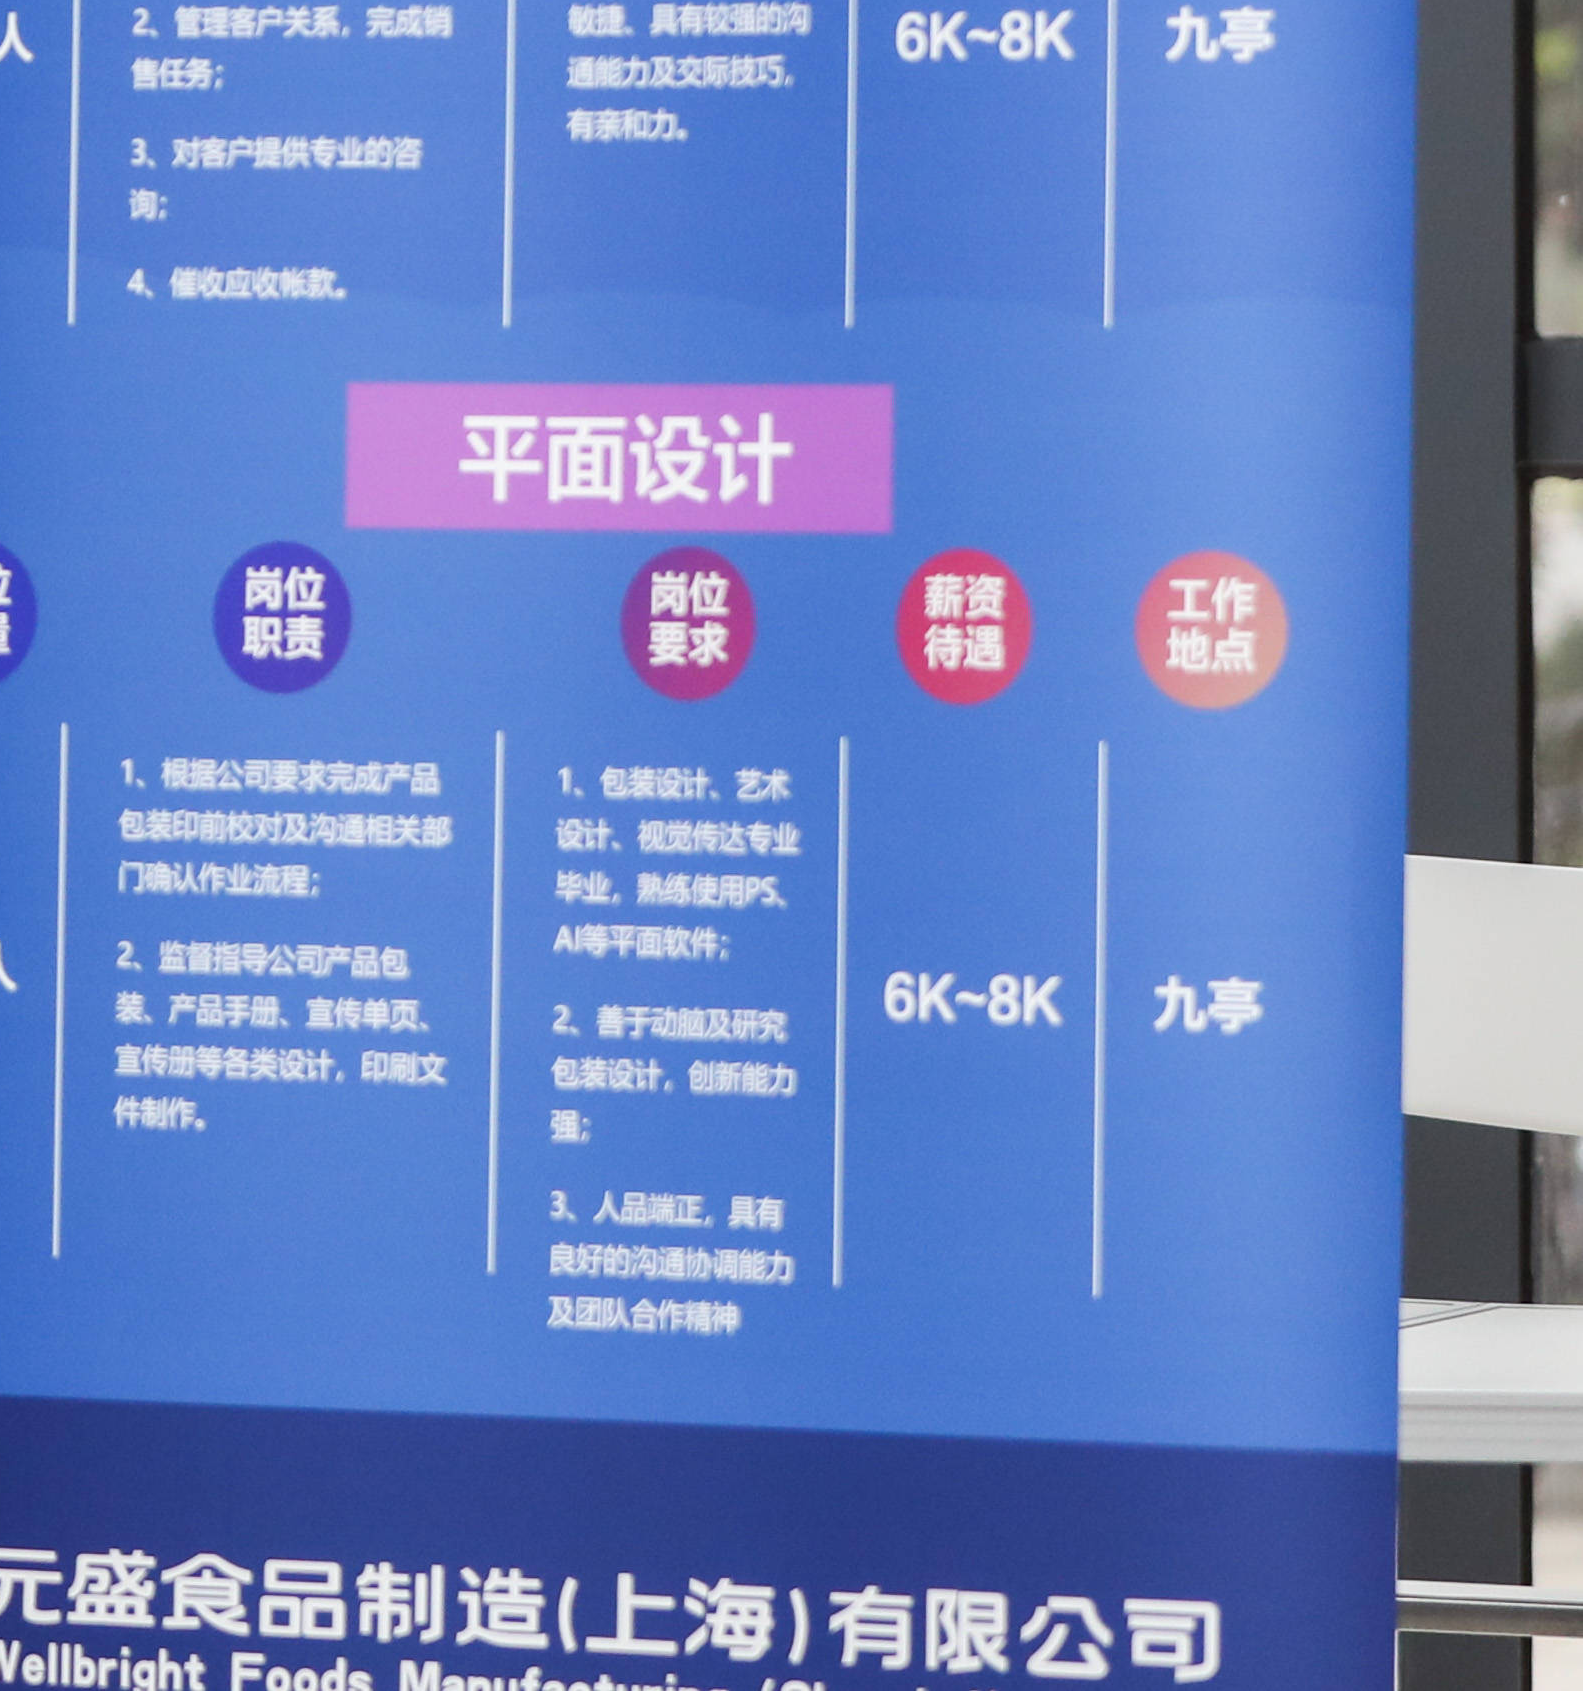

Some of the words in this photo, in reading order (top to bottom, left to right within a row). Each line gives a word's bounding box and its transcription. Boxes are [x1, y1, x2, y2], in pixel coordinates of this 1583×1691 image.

[896, 10, 1074, 62] 6K~8K
[1166, 5, 1275, 63] 九亭
[459, 413, 793, 504] 平面设计
[245, 566, 325, 610] 岗位
[651, 571, 729, 616] 岗位
[925, 574, 1005, 619] 薪资
[1168, 577, 1257, 624] 工作
[243, 615, 324, 660] 职责
[648, 621, 729, 666] 要求
[924, 624, 1005, 670] 待遇
[1167, 627, 1257, 673] 地点
[121, 757, 441, 795] 1、根据公司要求完成产品
[119, 809, 452, 847] 包装印前校对及沟通相关部
[884, 971, 1062, 1026] 6K~8K
[1154, 975, 1263, 1034] 九亭
[550, 1242, 794, 1284] 良好的沟通协调能力
[547, 1296, 741, 1334] 及团队合作精神
[231, 1651, 374, 1691] Foods
